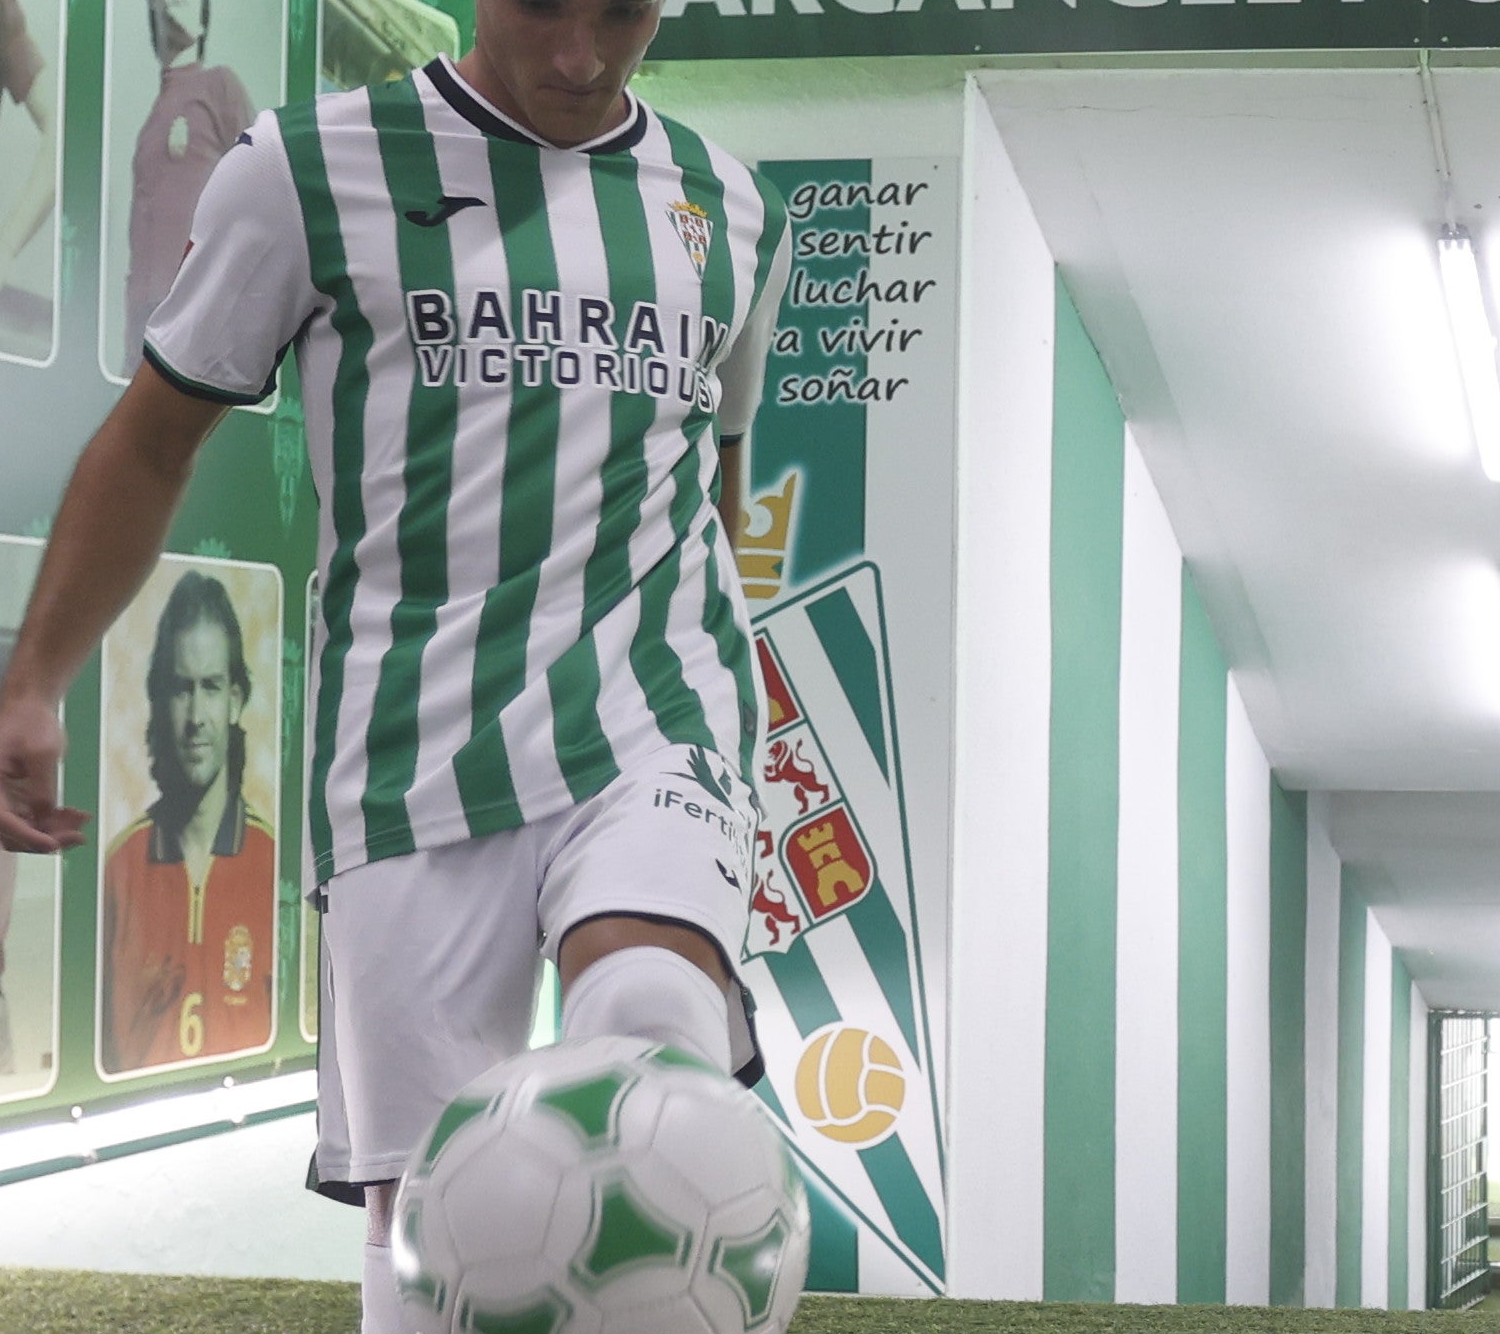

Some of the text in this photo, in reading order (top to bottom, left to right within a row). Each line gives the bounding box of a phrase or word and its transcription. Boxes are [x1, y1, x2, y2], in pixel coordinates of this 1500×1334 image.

[788, 181, 929, 220] ganar
[797, 220, 933, 256] sentir
[791, 270, 937, 306] luchar
[408, 289, 729, 370] BAHRAIN
[821, 319, 923, 354] vivir
[417, 345, 715, 413] VICTORIOUS
[778, 368, 910, 403] soñar
[180, 991, 204, 1057] 6
